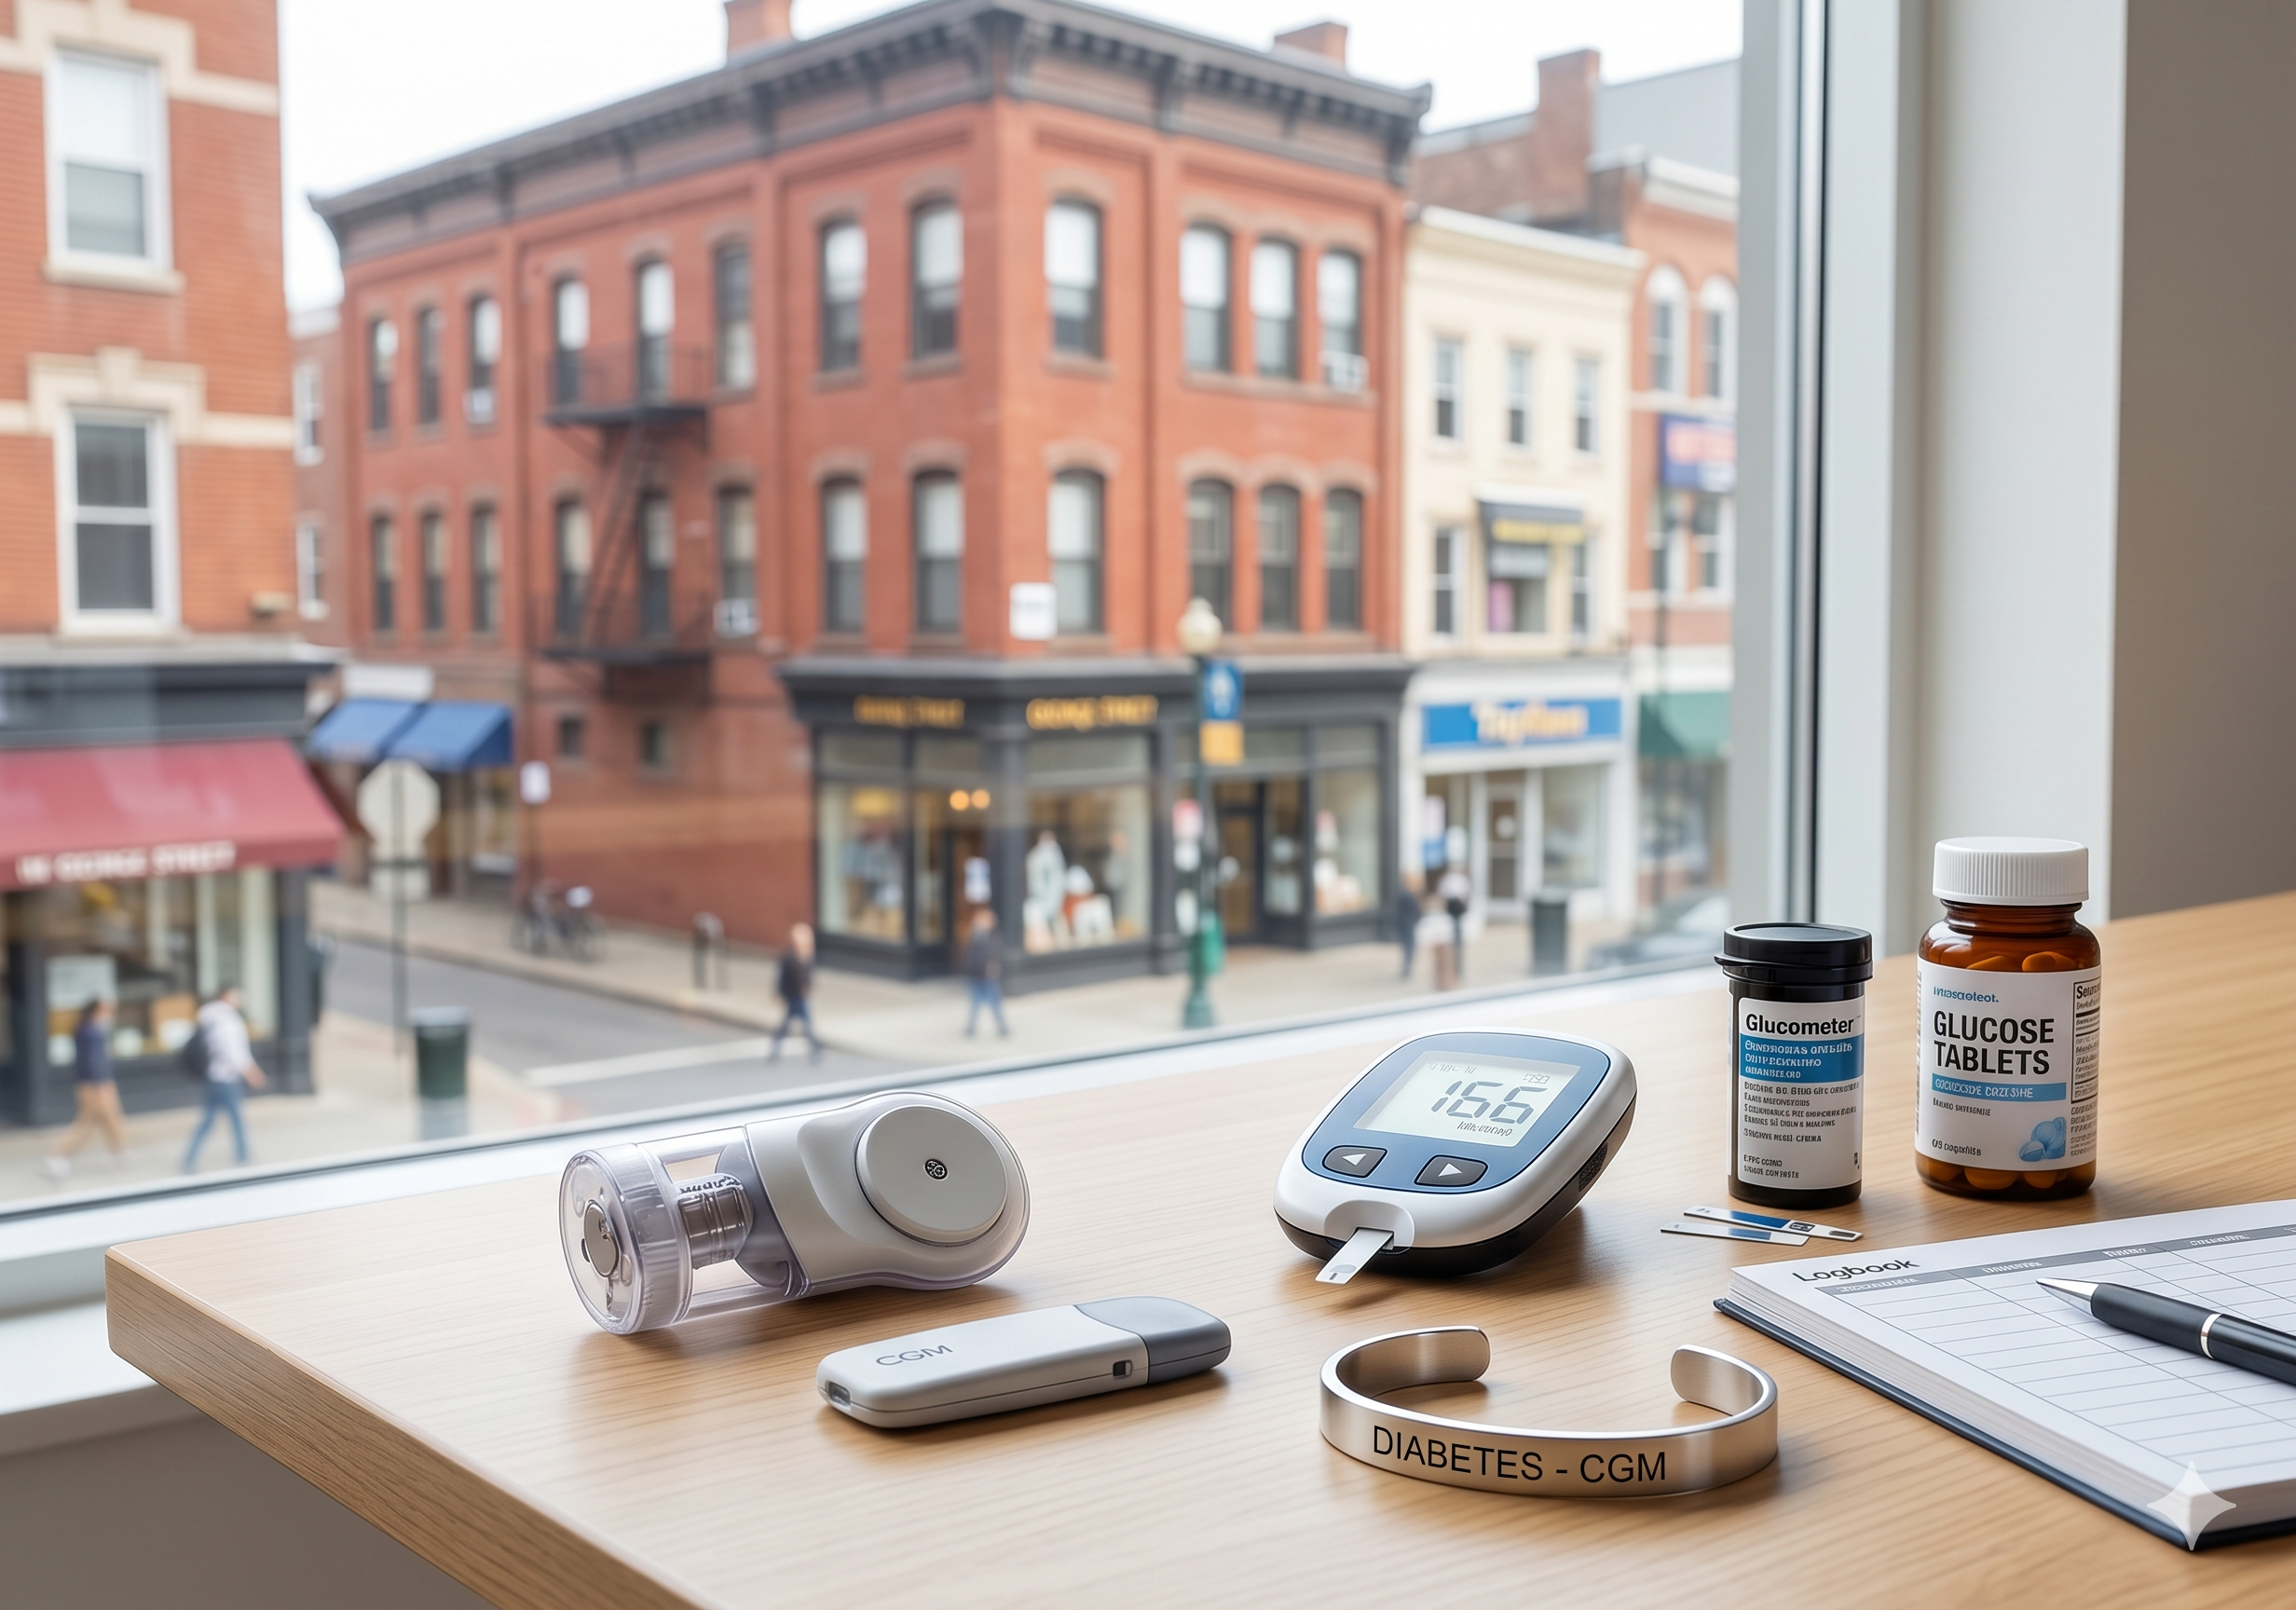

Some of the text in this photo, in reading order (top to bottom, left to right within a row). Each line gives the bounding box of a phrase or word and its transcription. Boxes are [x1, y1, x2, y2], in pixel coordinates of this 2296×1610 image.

[1745, 1013, 1853, 1035] Glucometer
[1934, 1010, 2055, 1044] GLUCOSE
[1934, 1040, 2050, 1075] TABLETS
[1430, 1080, 1549, 1125] 166
[1792, 1259, 1920, 1282] Logbook
[875, 1344, 953, 1366] CGM
[1374, 1425, 1543, 1480] DIABETES
[1579, 1452, 1666, 1483] CGM
